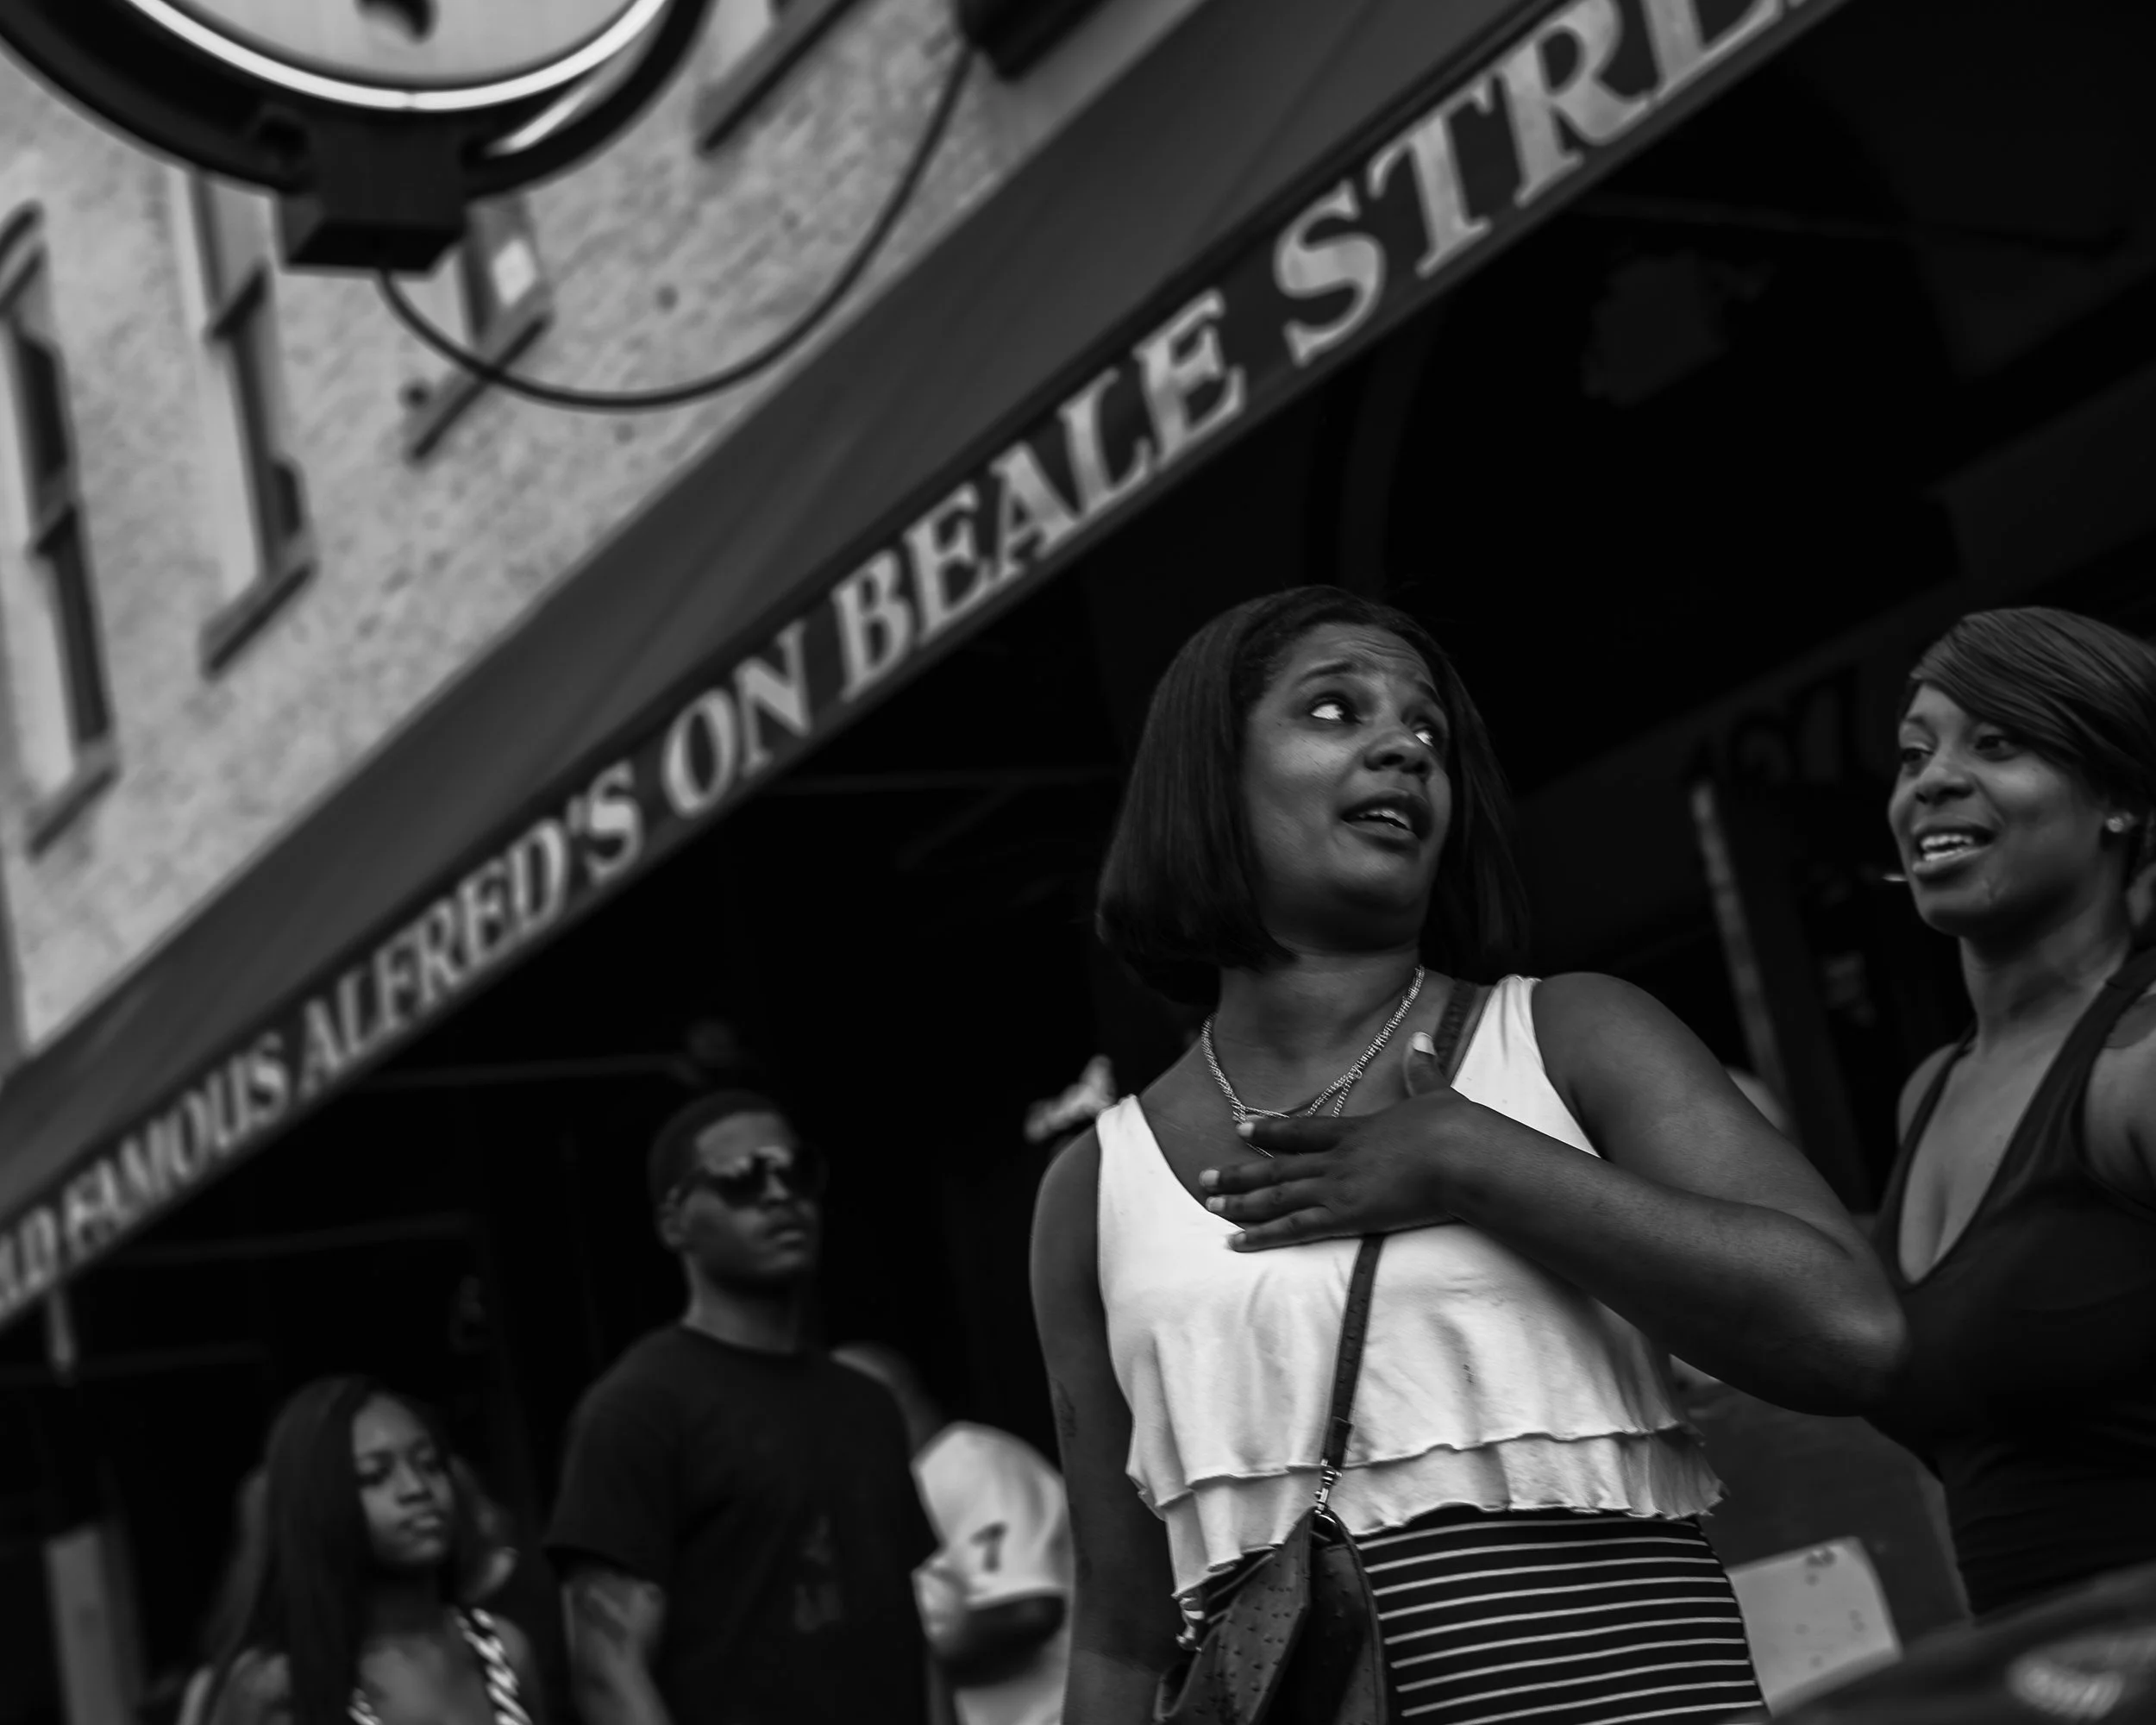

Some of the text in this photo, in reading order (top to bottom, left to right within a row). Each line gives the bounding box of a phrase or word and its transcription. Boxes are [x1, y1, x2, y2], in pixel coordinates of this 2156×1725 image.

[62, 1031, 291, 1264] FAMOUS
[293, 756, 643, 1102] ALFRED'S
[660, 617, 813, 819] ON
[828, 287, 1248, 704] BEALE
